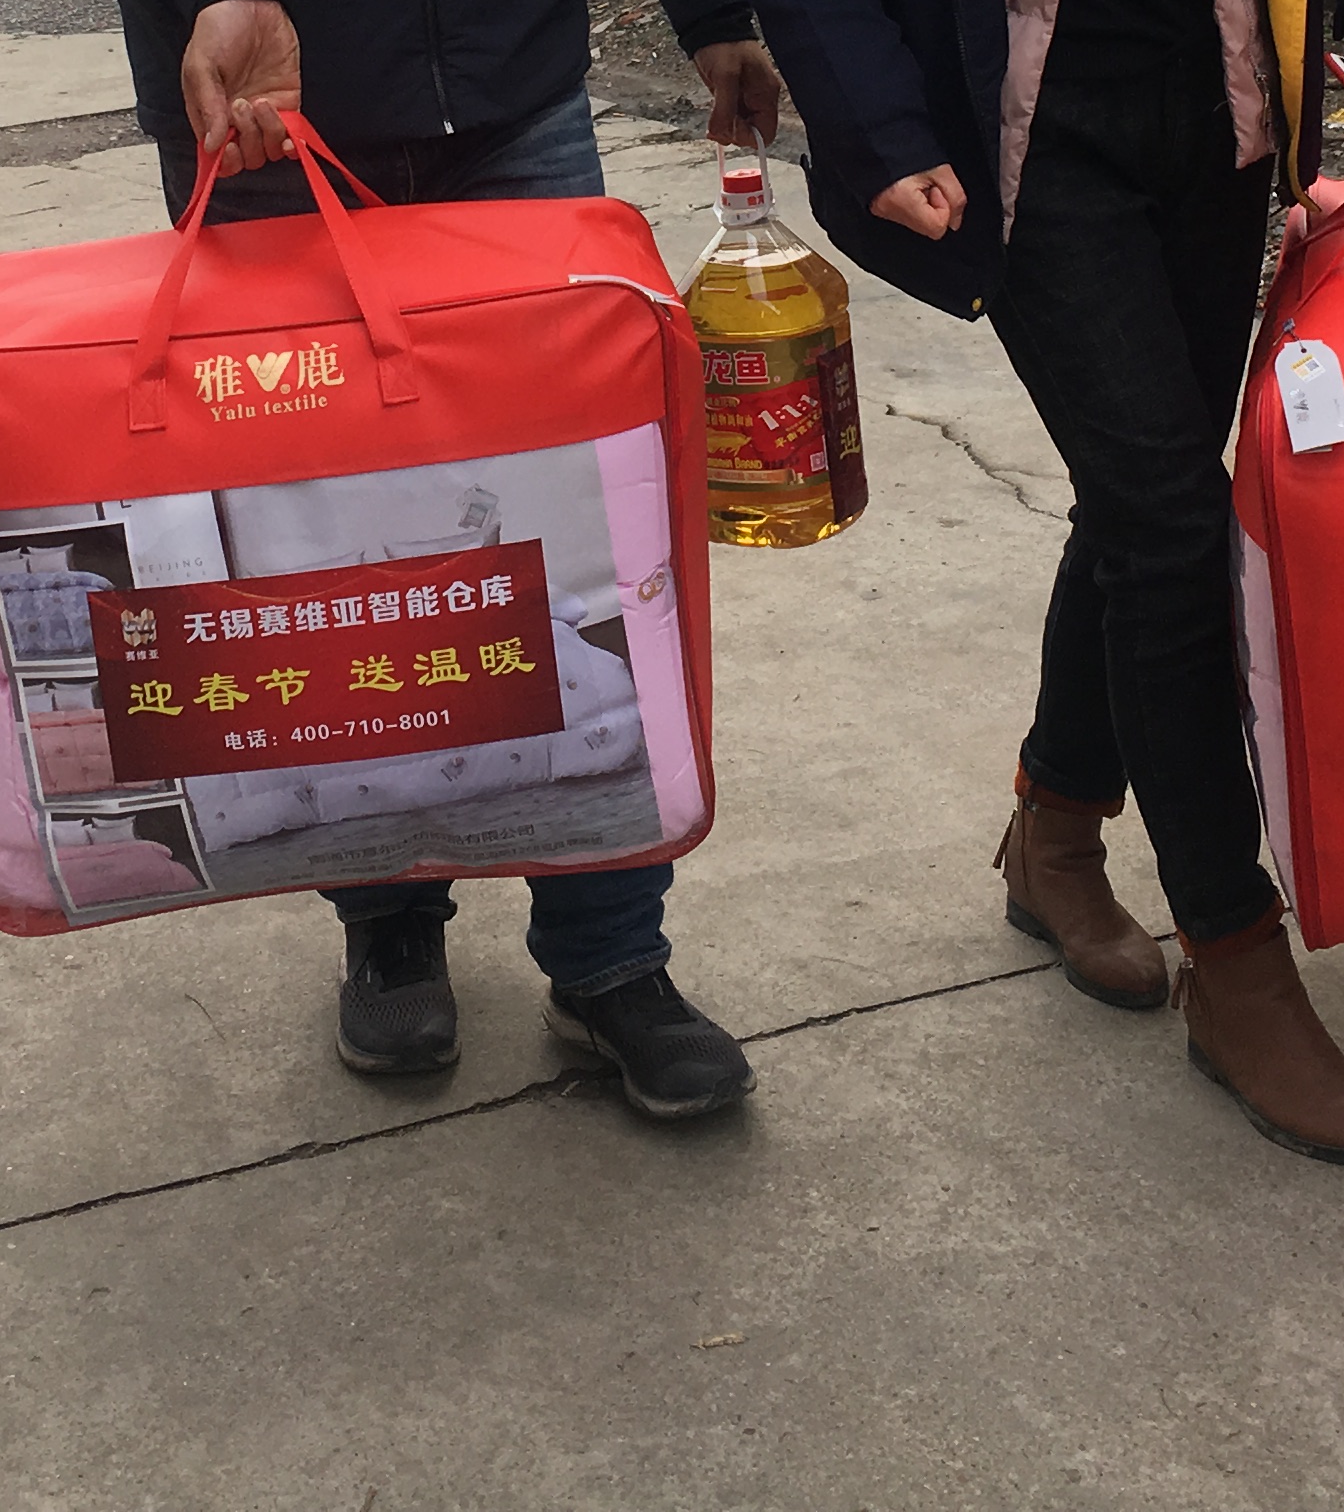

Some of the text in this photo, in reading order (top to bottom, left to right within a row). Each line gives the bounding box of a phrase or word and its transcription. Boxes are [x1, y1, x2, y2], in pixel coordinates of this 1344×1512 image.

[210, 394, 328, 422] Yalu textile
[758, 394, 818, 431] 1:1:1
[184, 575, 514, 644] 无锡赛维亚智能仓库
[127, 637, 536, 716] 迎春节 送温暖
[291, 709, 451, 743] 400-710-8001
